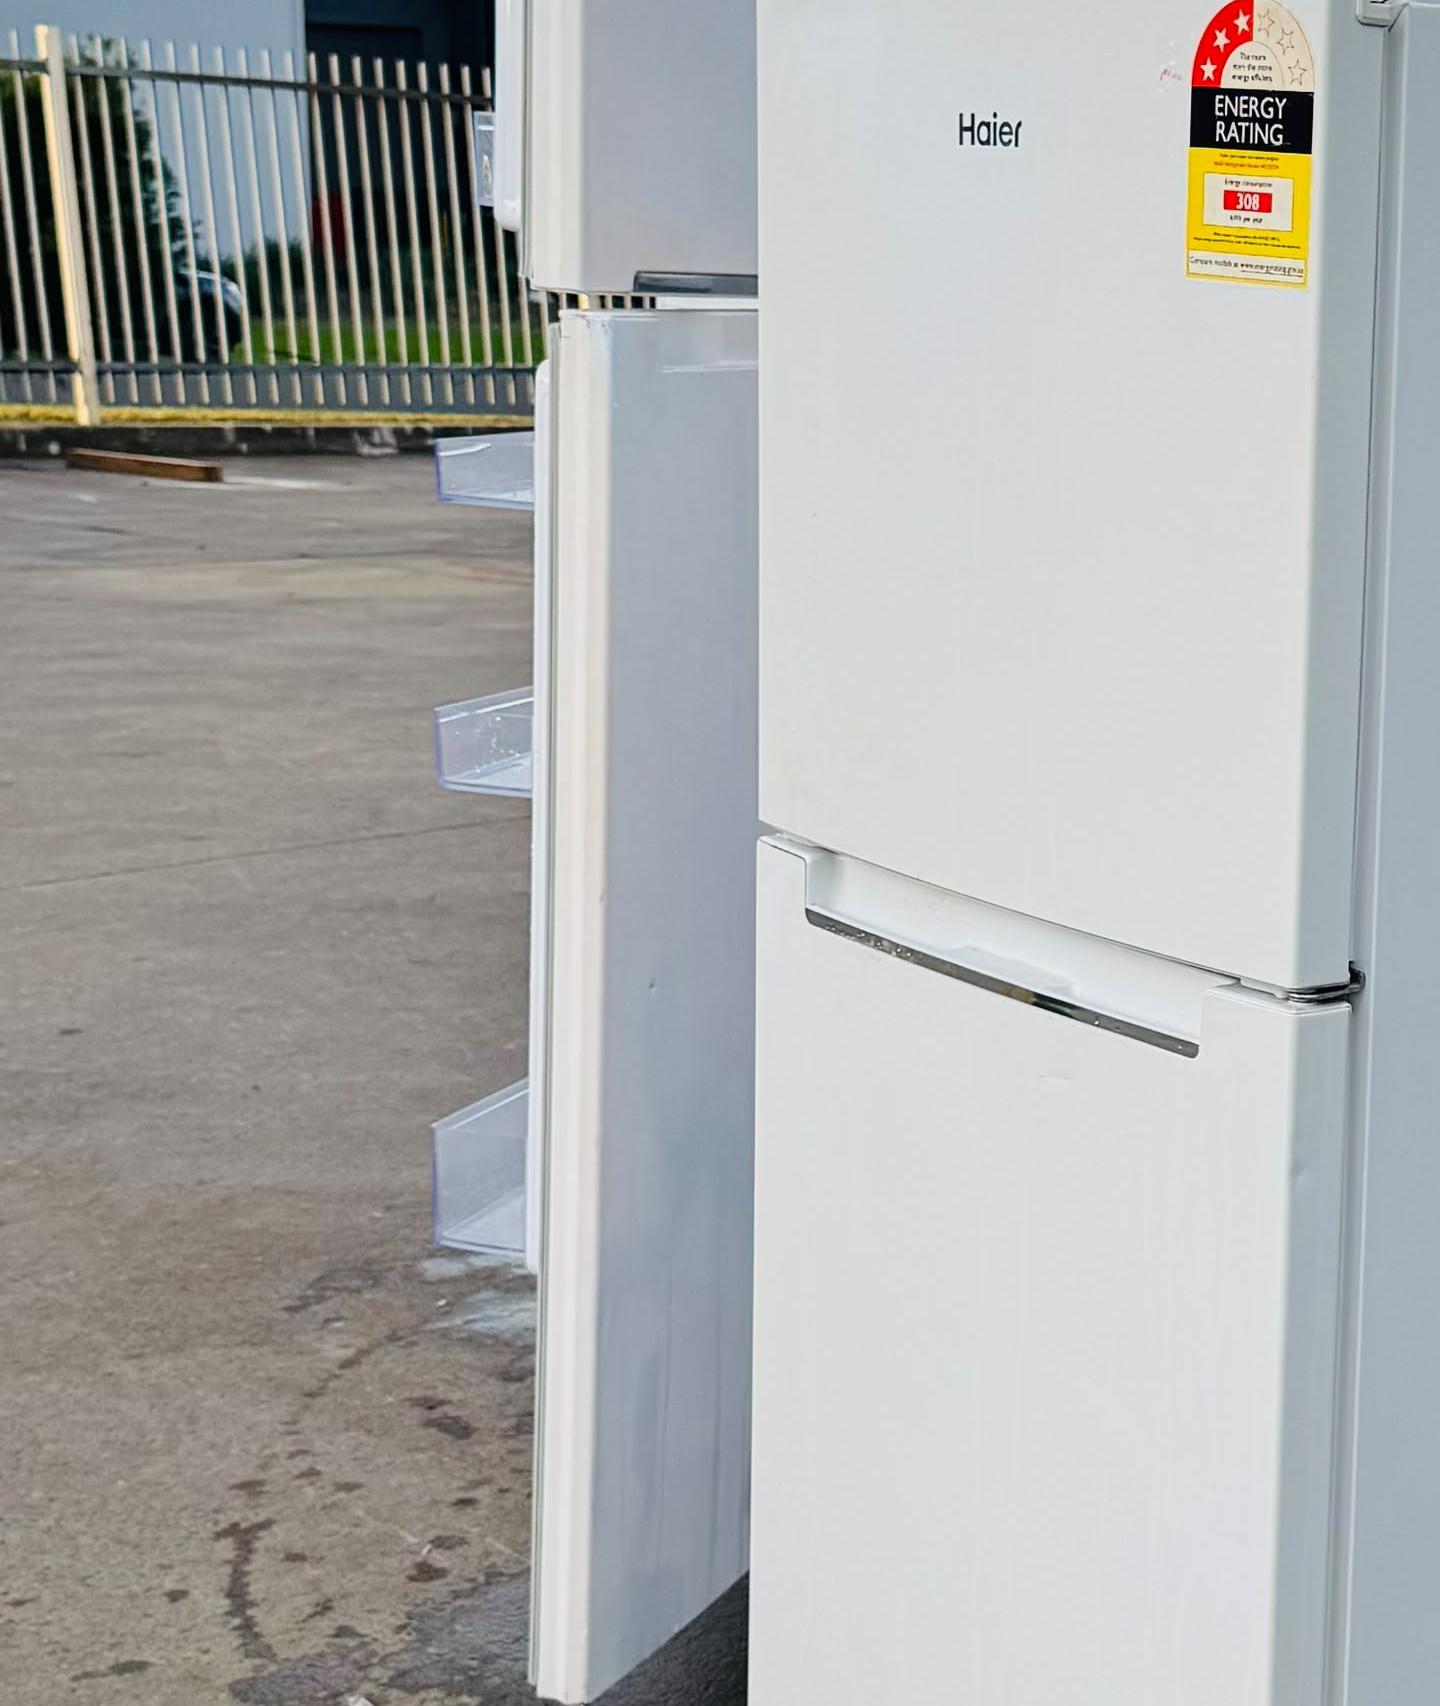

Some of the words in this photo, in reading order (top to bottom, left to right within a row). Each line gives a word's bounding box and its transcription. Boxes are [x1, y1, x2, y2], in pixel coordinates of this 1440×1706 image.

[1214, 94, 1287, 120] ENERGY
[958, 111, 1022, 147] Haier
[1215, 120, 1284, 146] RATING
[1235, 193, 1260, 211] 308
